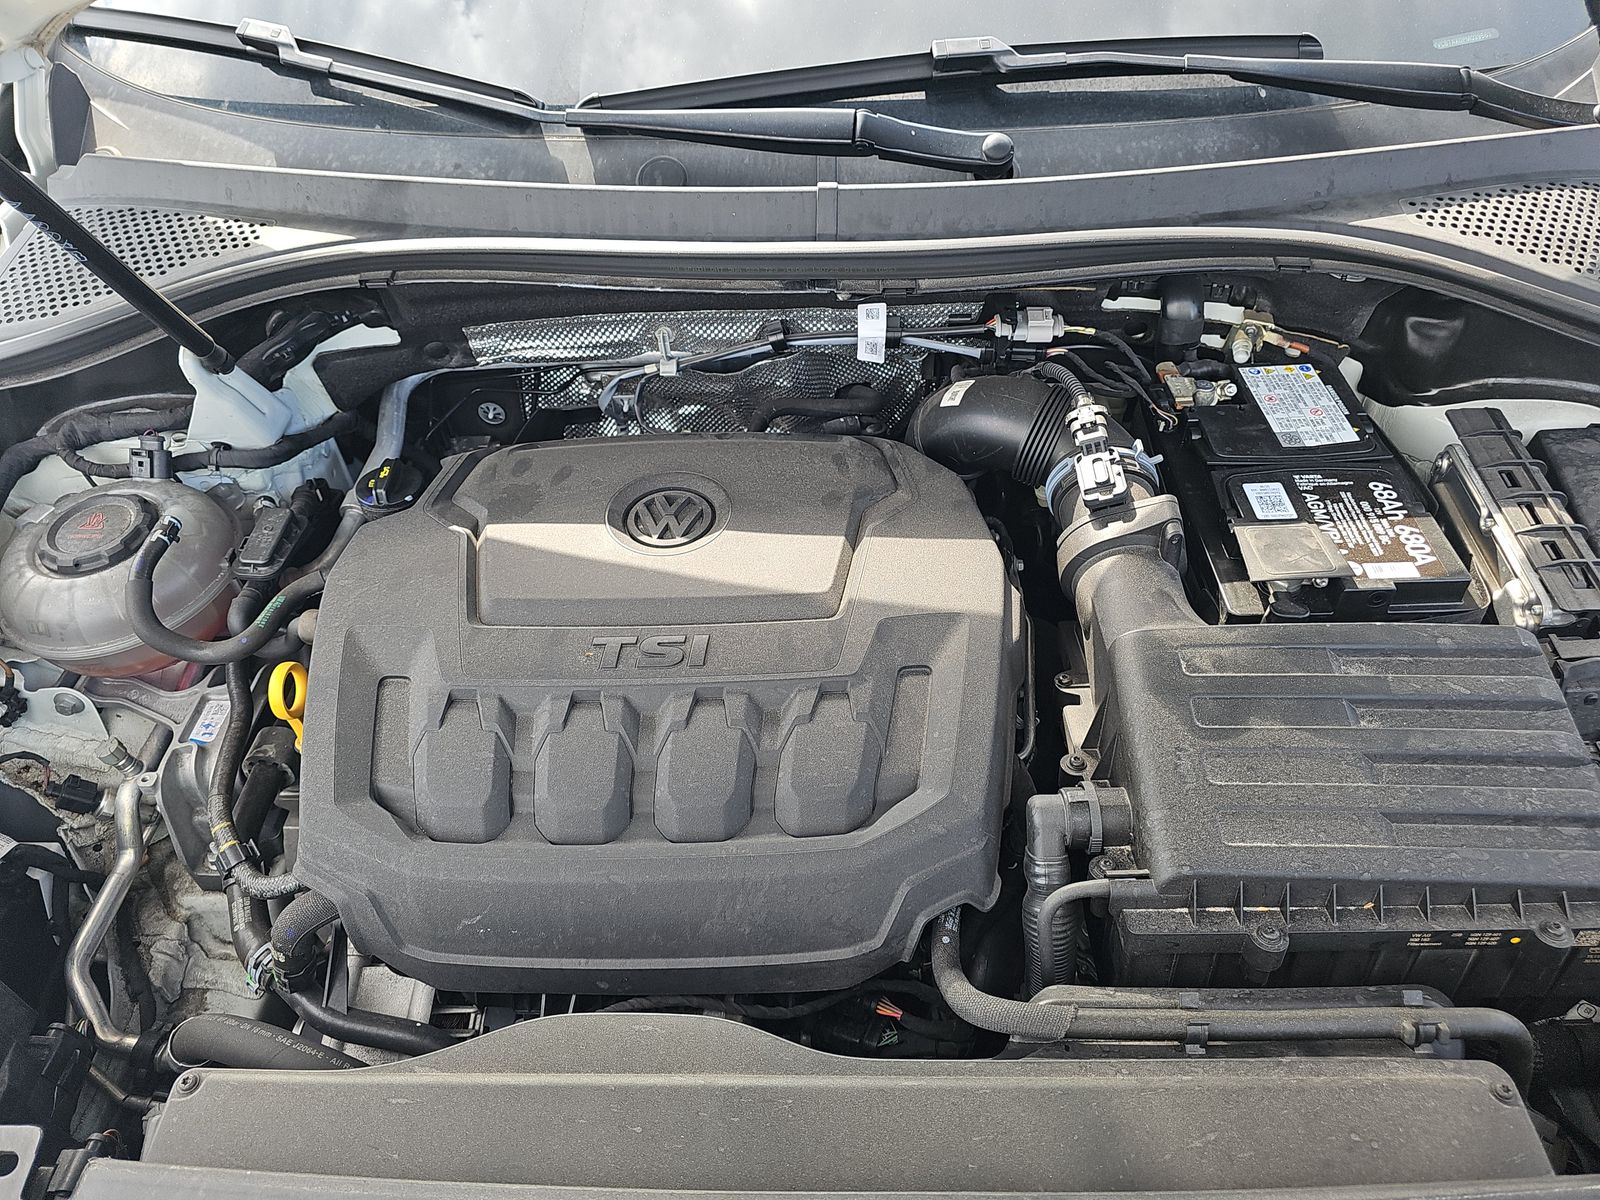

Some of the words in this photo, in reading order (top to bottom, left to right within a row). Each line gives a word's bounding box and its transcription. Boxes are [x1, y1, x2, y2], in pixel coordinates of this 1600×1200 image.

[627, 490, 712, 546] VW
[1302, 493, 1349, 555] AGM/VR
[1368, 481, 1409, 520] 68Ah
[1393, 524, 1437, 566] 680A
[592, 634, 710, 669] TSI
[275, 1034, 294, 1046] SAE
[329, 1058, 342, 1067] All
